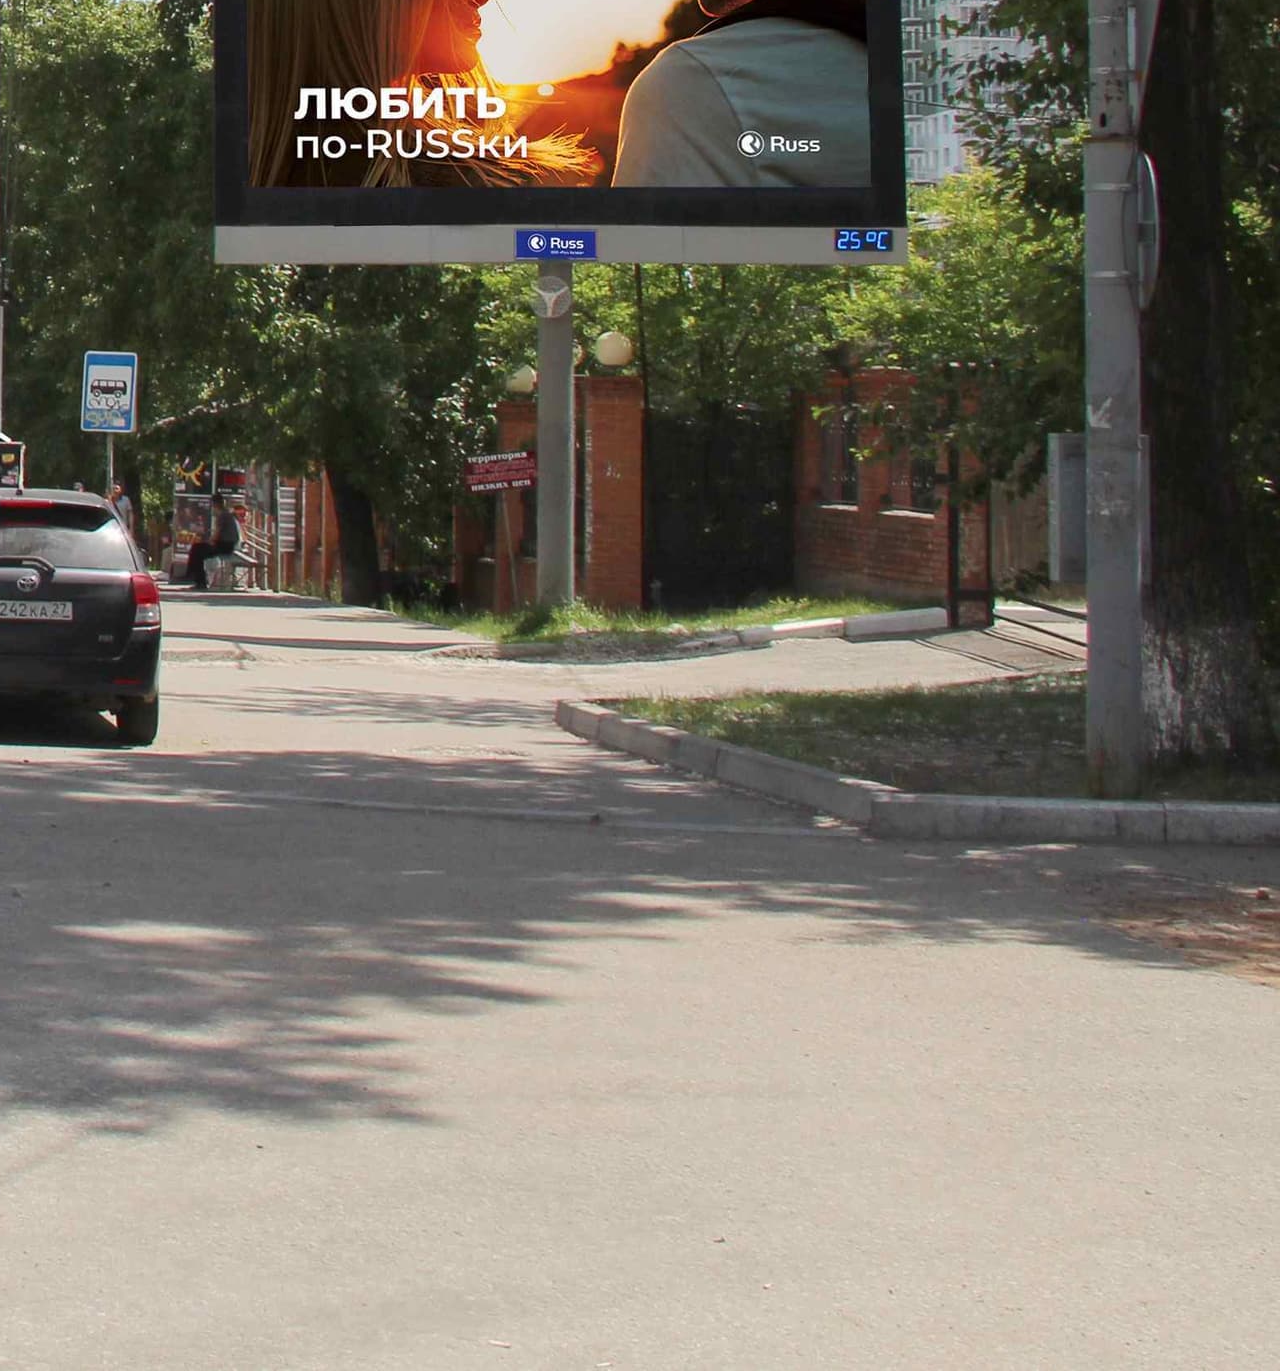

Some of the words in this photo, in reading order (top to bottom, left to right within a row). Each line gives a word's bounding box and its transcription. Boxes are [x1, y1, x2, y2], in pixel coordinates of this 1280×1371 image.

[294, 87, 507, 120] ЛЮБИТЬ
[296, 129, 528, 159] по-RUSSки
[770, 135, 821, 152] Russ
[550, 237, 584, 249] Russ
[837, 231, 861, 249] 25
[467, 452, 528, 464] территория
[471, 481, 509, 492] низких
